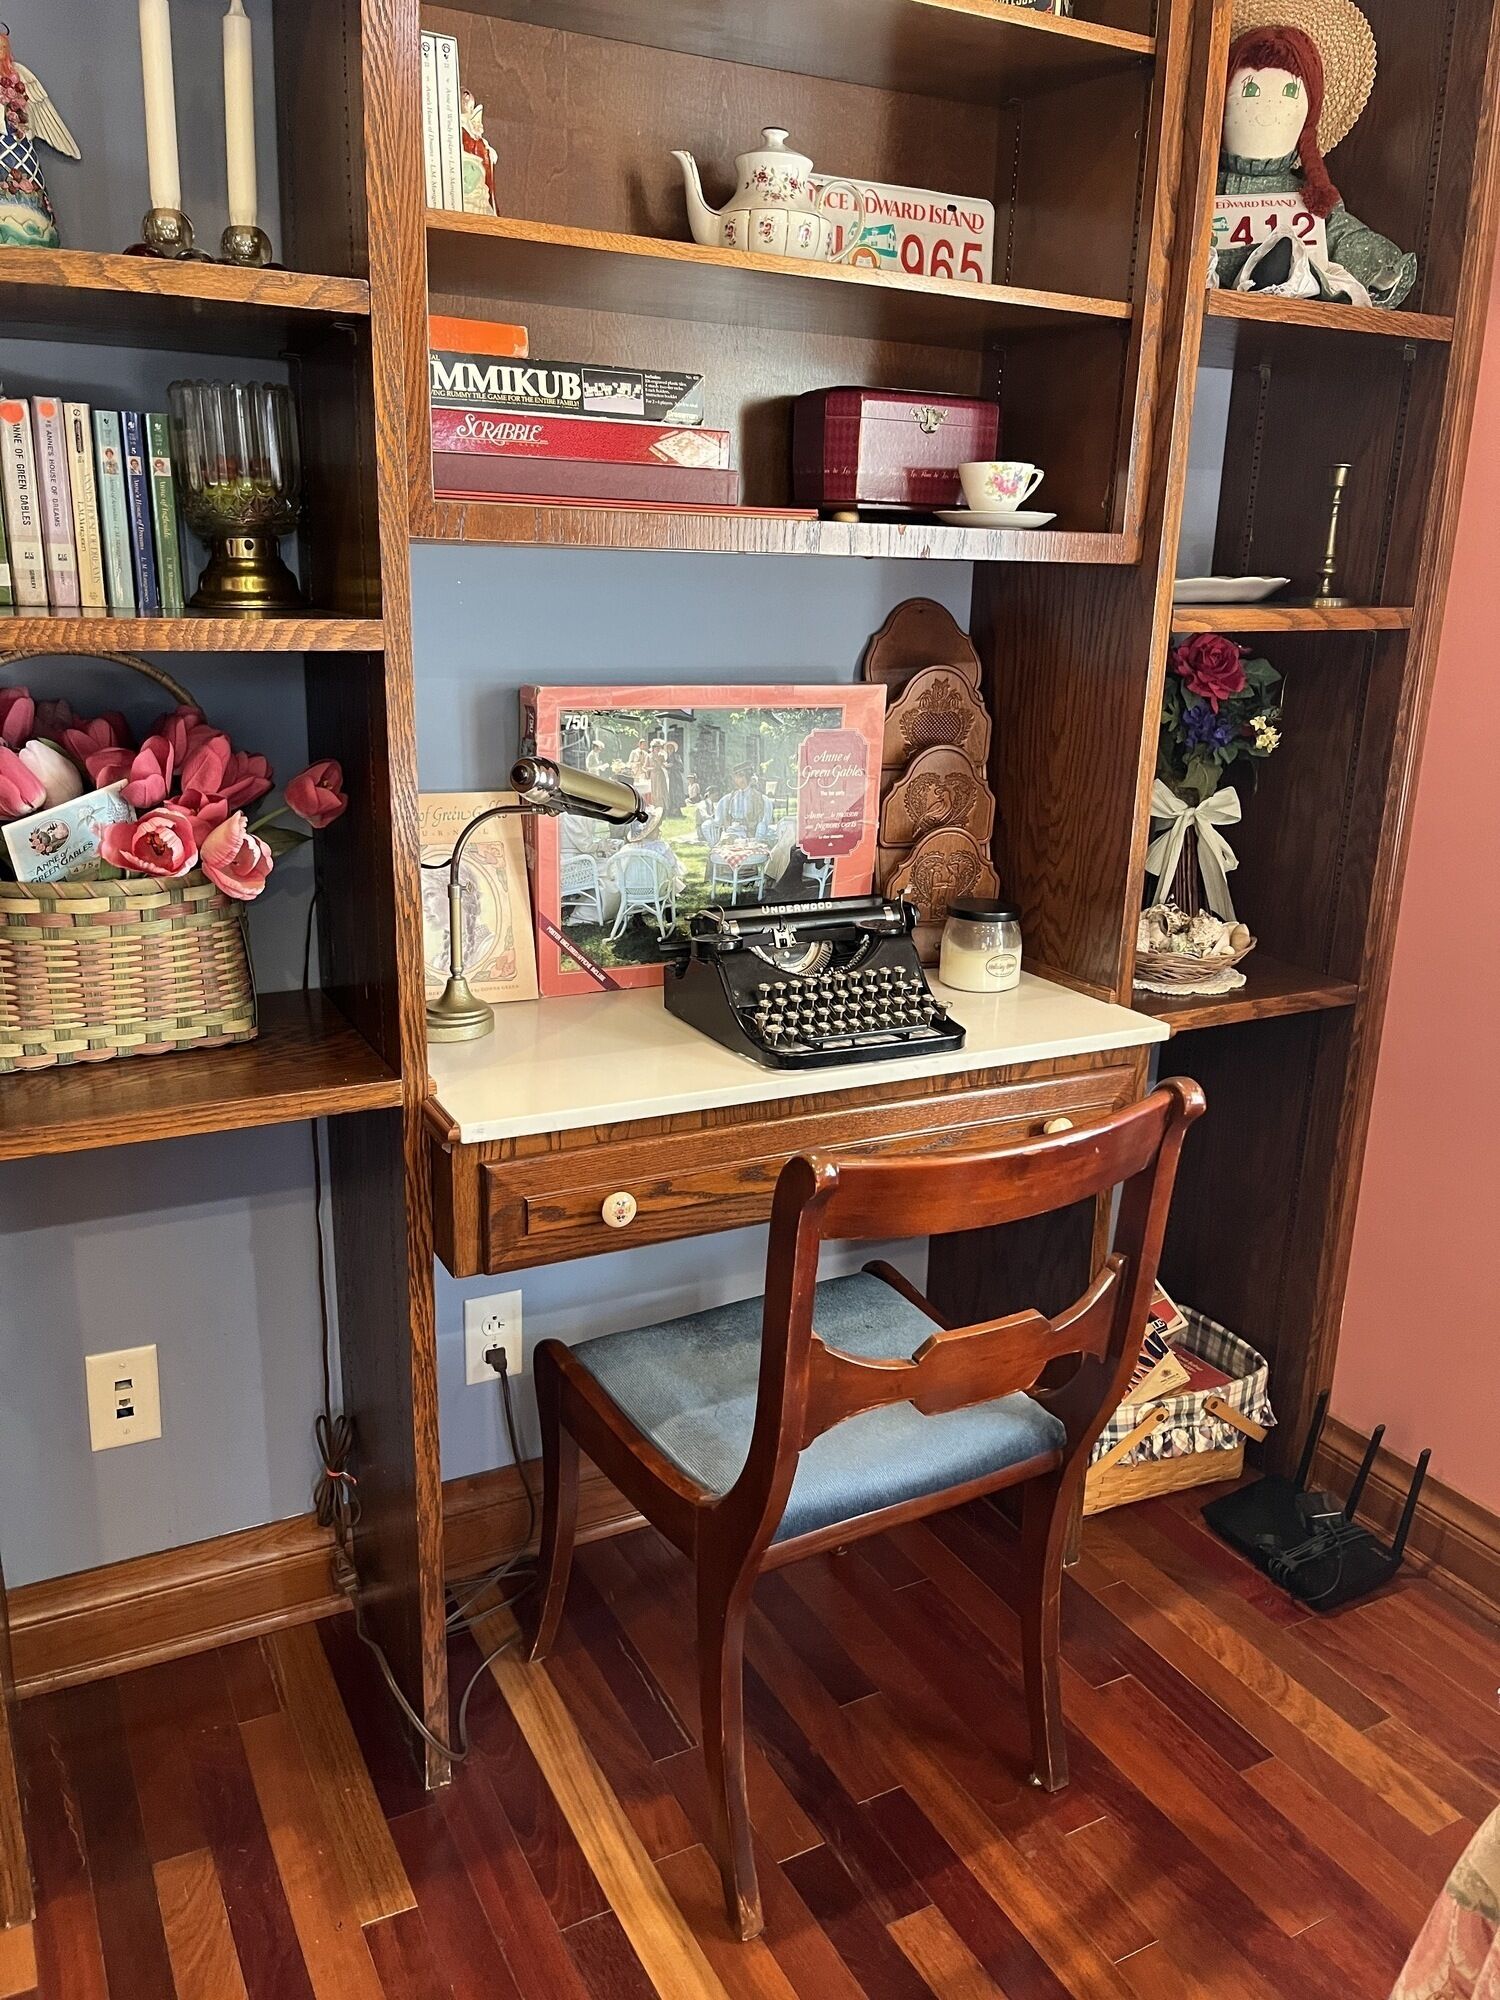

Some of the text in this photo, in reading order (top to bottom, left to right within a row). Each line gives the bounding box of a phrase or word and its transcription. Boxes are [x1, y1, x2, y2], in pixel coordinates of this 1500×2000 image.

[1216, 199, 1297, 209] EDWARD ISLAND
[929, 204, 985, 234] ISLAND
[1230, 212, 1317, 245] 412
[901, 233, 983, 284] 965
[430, 361, 582, 400] MMIKUB
[446, 390, 471, 398] RUMMY
[473, 392, 486, 400] TILE
[487, 393, 507, 401] GAME
[535, 396, 557, 405] ENTIRE
[15, 448, 24, 459] OF
[46, 430, 54, 456] ANNE'S
[131, 447, 137, 455] 5
[16, 463, 27, 490] GREEN
[49, 459, 57, 483] HOUSE
[51, 485, 58, 495] OF
[20, 495, 31, 526] GABLES
[52, 498, 60, 527] DREAMS
[564, 714, 588, 730] 750
[814, 750, 852, 763] Anne of
[786, 765, 865, 790] Green Gables
[36, 854, 59, 875] ANNE
[61, 841, 94, 865] GABLES
[761, 902, 833, 914] UNDERWOOD
